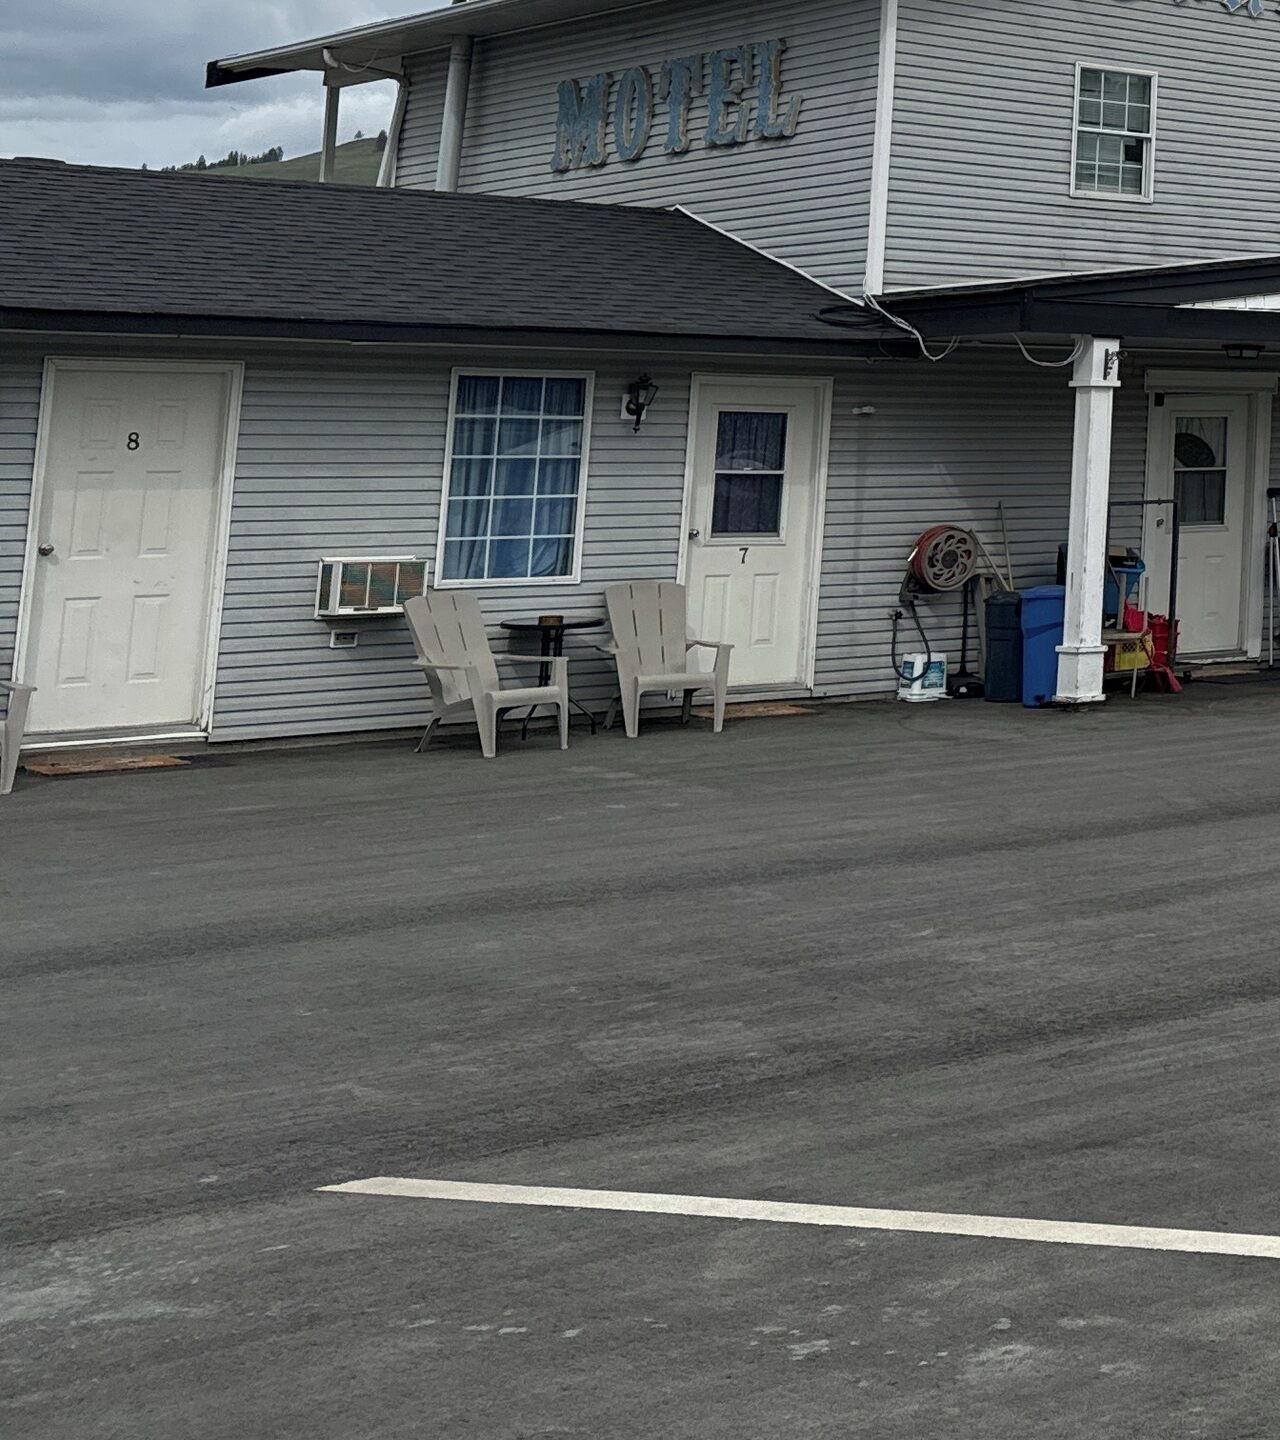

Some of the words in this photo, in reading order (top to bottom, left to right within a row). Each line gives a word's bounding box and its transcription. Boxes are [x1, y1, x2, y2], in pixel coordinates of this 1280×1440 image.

[550, 38, 803, 172] MOTEL
[127, 432, 140, 451] 8
[739, 547, 749, 564] 7
